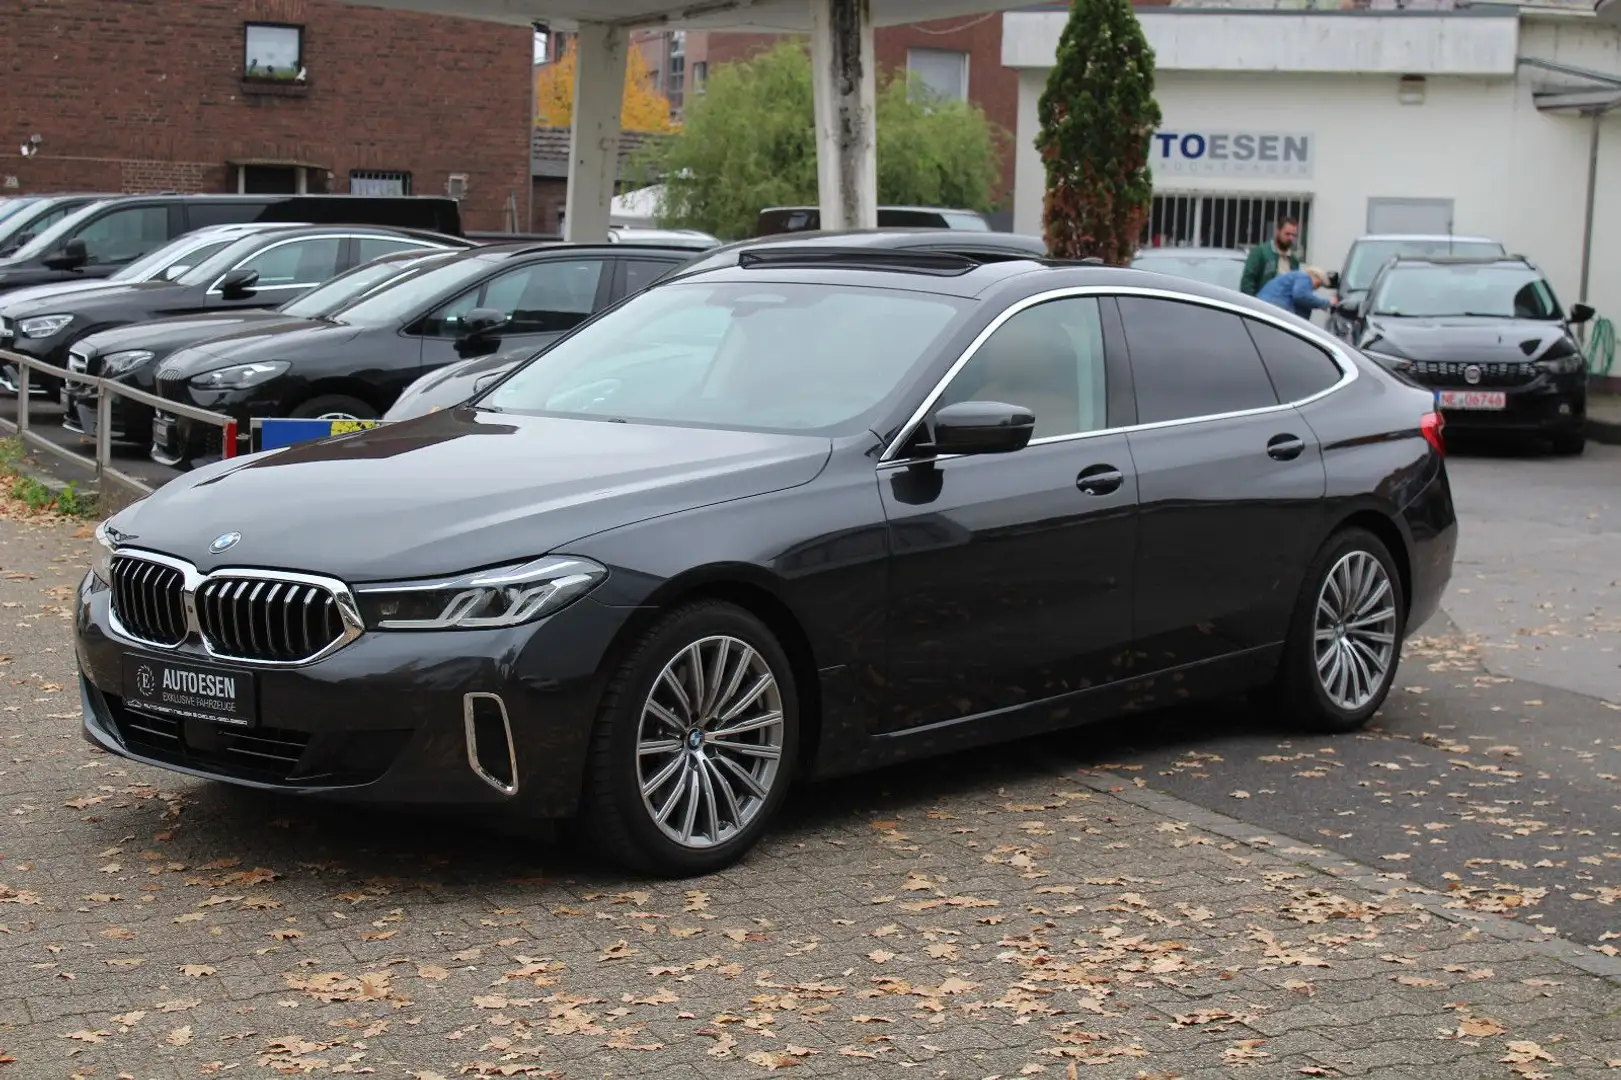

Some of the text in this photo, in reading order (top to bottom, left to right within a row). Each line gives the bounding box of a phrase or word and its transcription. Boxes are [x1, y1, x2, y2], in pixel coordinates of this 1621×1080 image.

[162, 668, 236, 699] AUTOESEN
[162, 692, 196, 707] EXKLUSIVE
[196, 697, 237, 713] FAHRZEUGE
